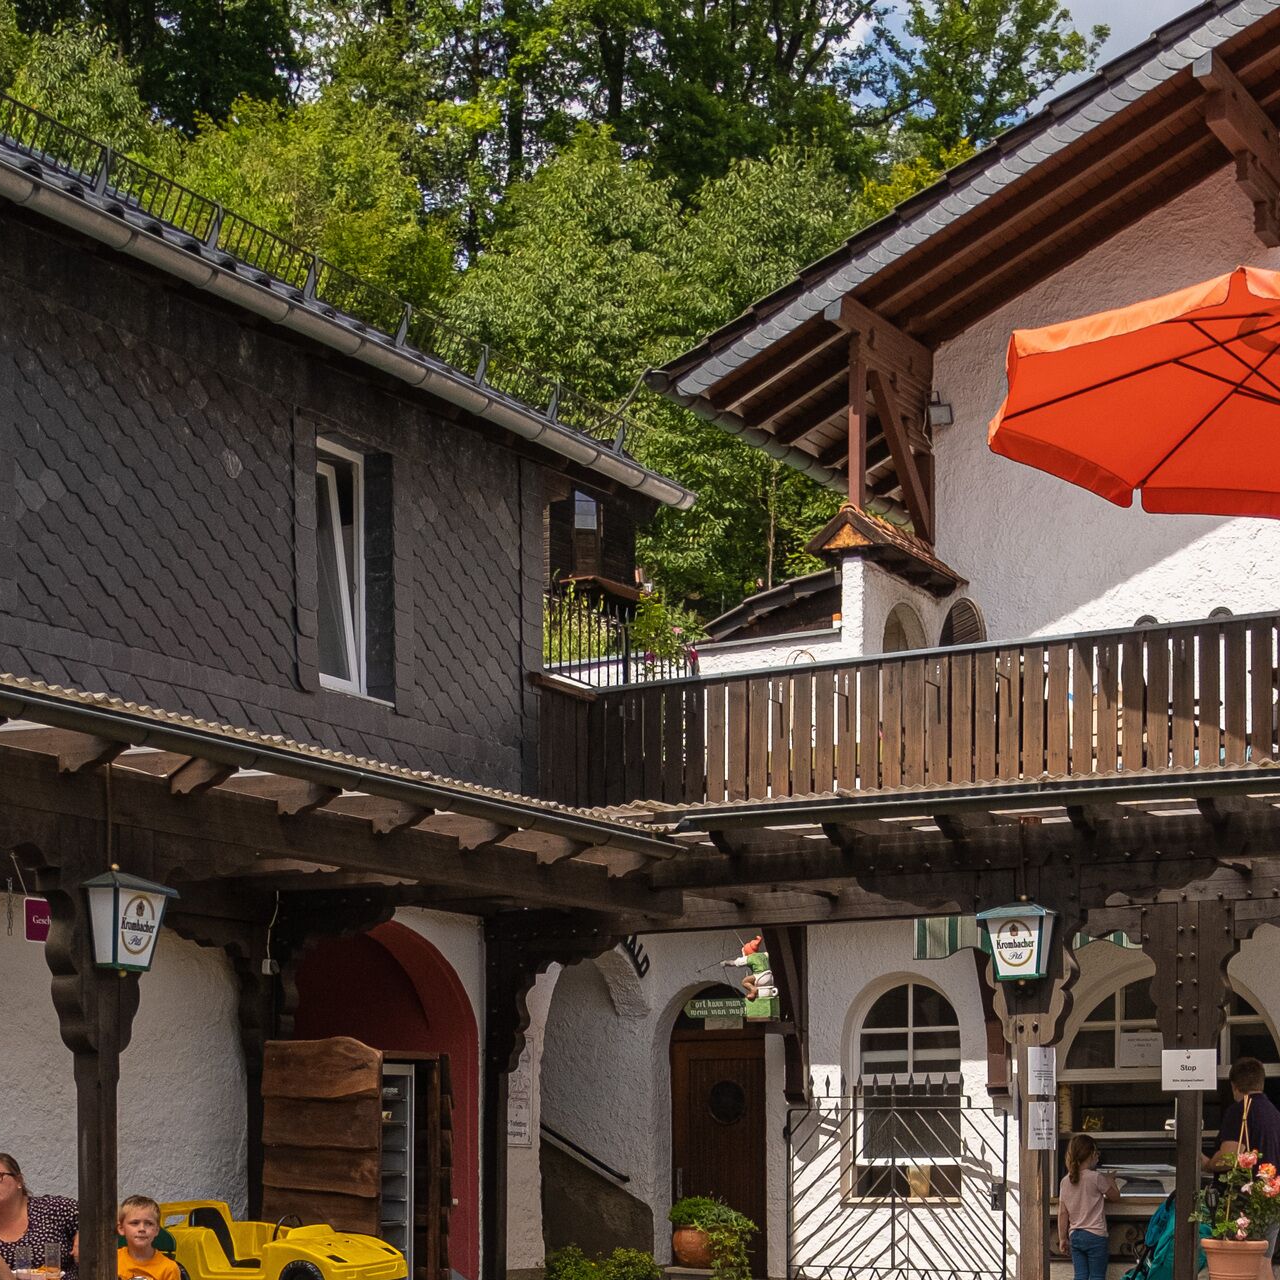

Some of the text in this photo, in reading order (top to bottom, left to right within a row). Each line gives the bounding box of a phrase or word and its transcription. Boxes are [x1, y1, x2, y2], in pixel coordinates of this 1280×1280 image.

[32, 915, 51, 926] Gesch
[121, 916, 155, 934] Krombacher
[996, 938, 1034, 950] Krombacher
[625, 934, 650, 978] ALD
[1008, 951, 1024, 961] Pils
[1180, 1064, 1197, 1072] Stop
